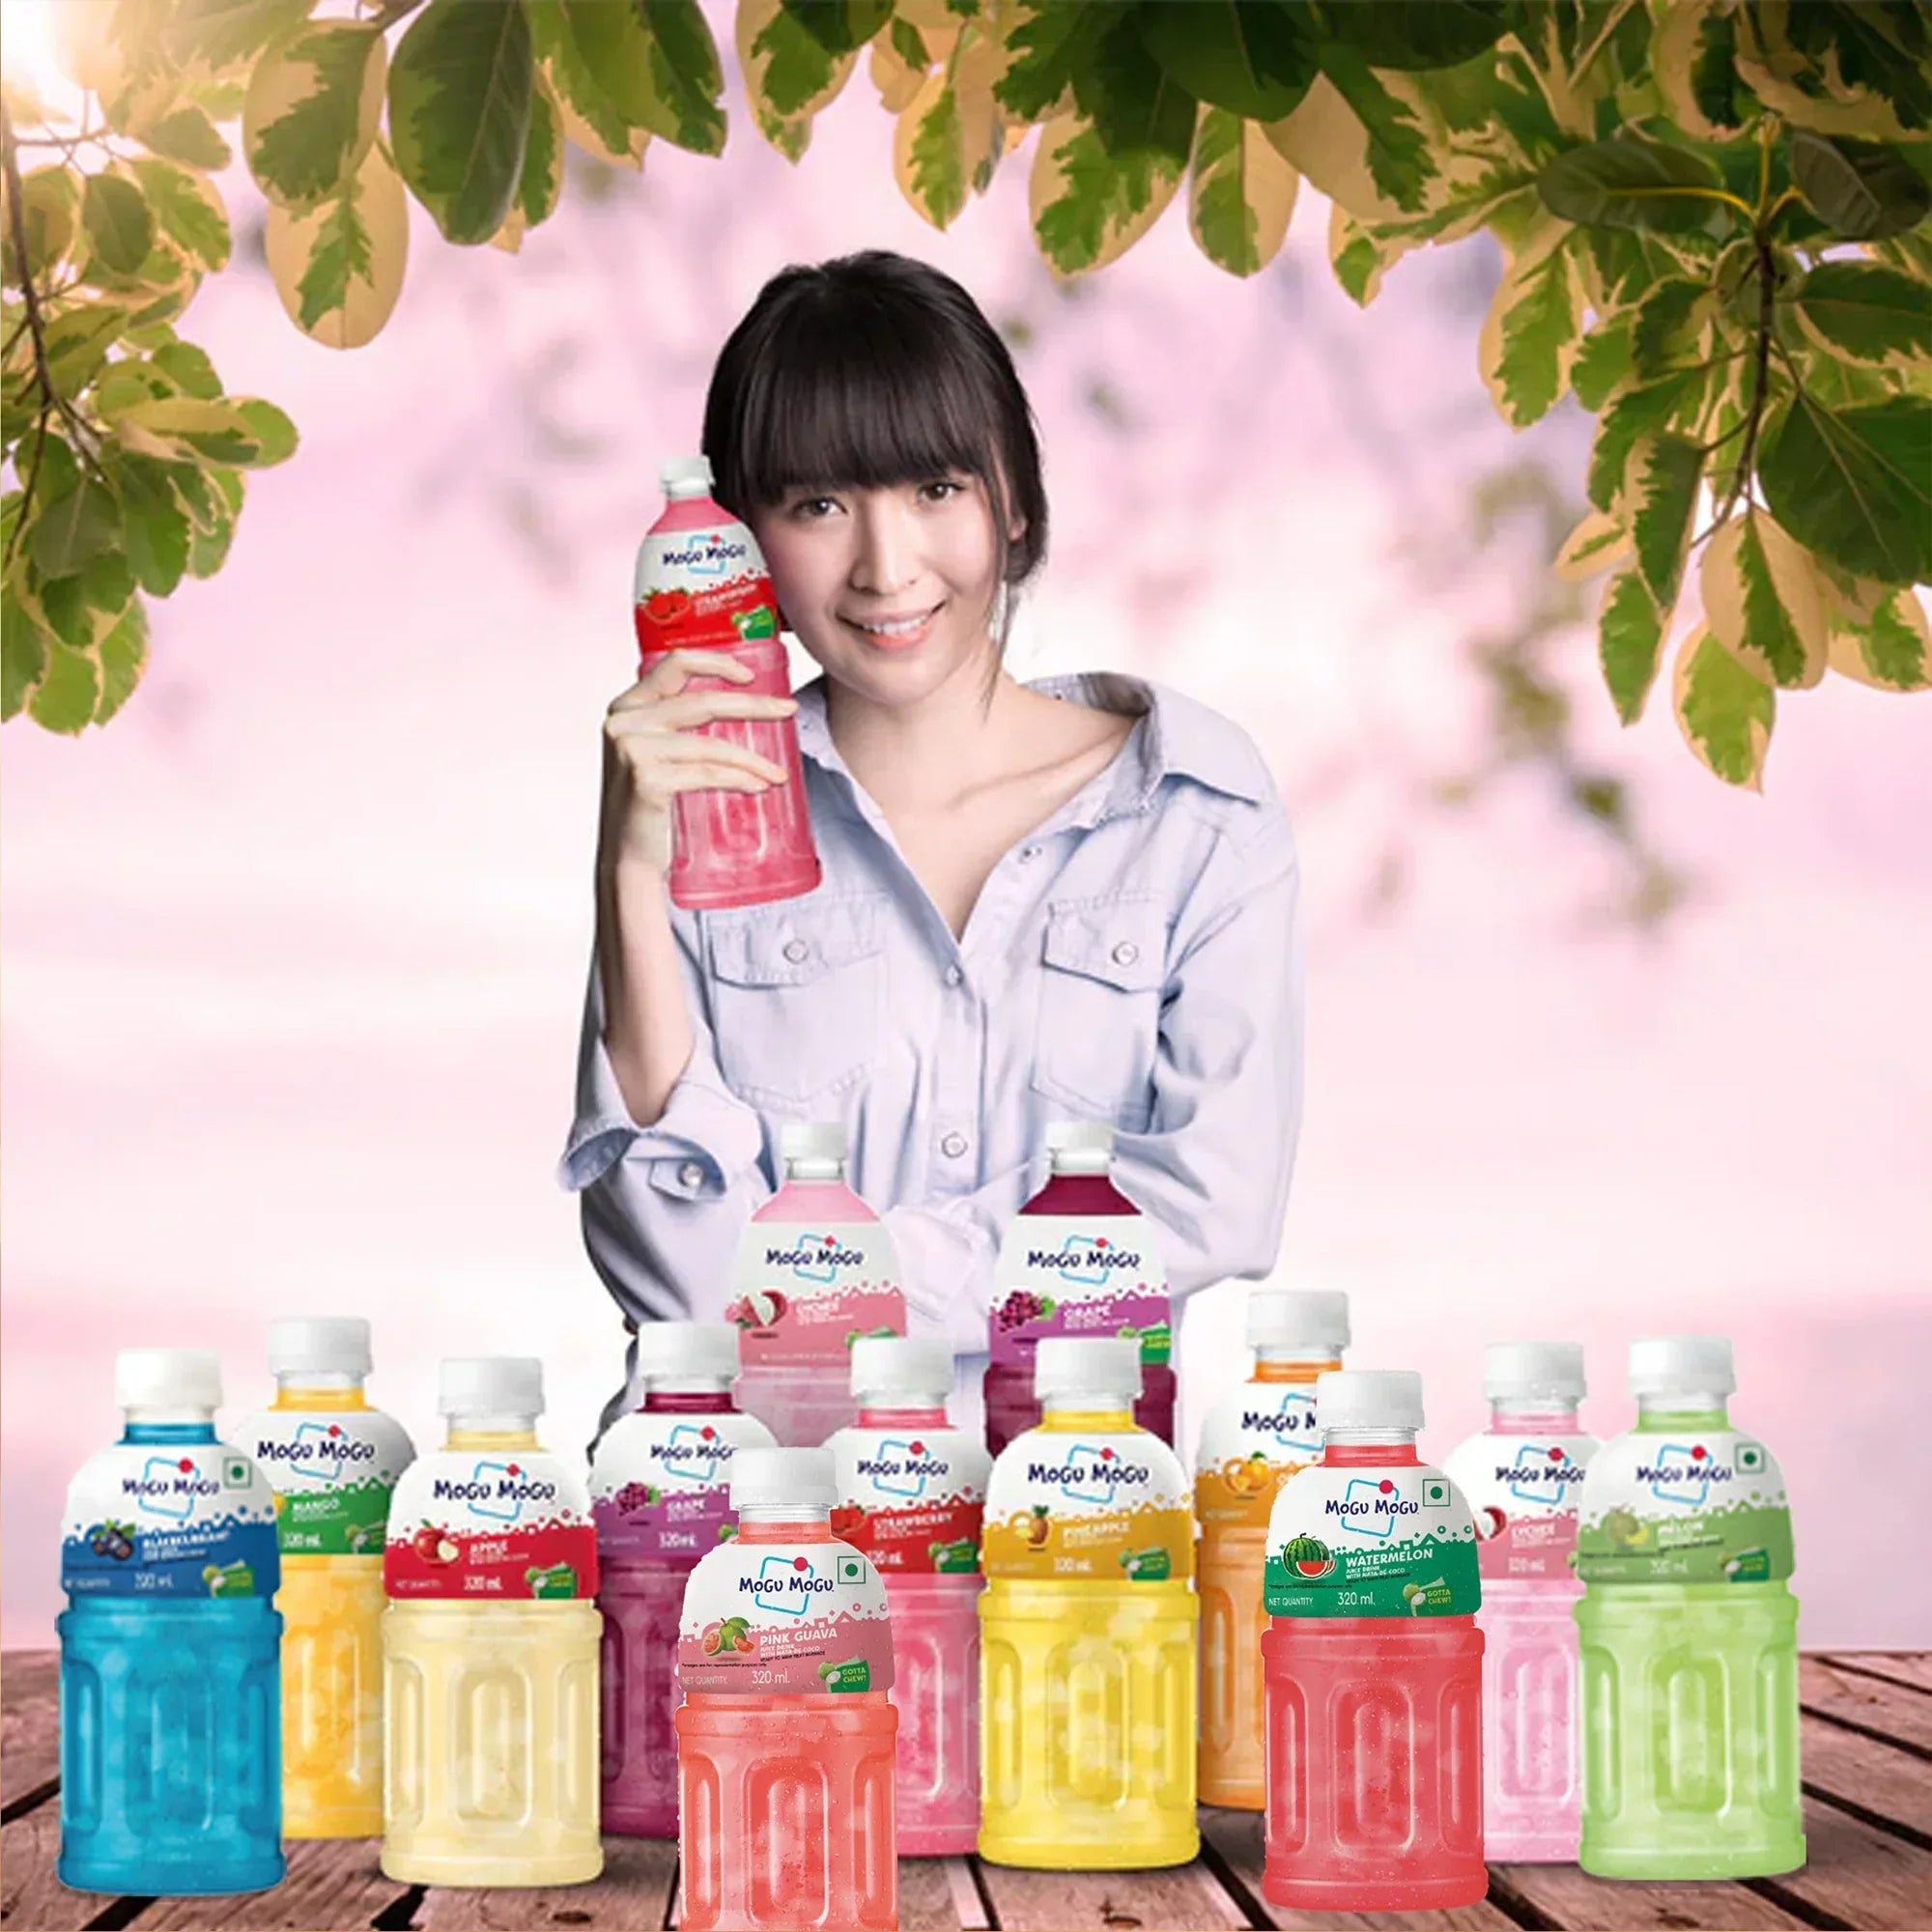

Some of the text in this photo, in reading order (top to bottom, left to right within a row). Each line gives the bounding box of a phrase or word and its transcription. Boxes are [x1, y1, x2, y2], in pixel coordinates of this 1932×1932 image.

[1346, 1548, 1434, 1568] WATERMELON
[1337, 1592, 1357, 1605] 320
[1427, 1589, 1451, 1598] GOTTA
[1268, 1597, 1313, 1606] NET QUANTITY
[760, 1628, 838, 1646] PINK GUAVA
[752, 1670, 772, 1684] 320
[842, 1667, 867, 1676] GOTTA
[681, 1675, 728, 1686] NET QUANTITY
